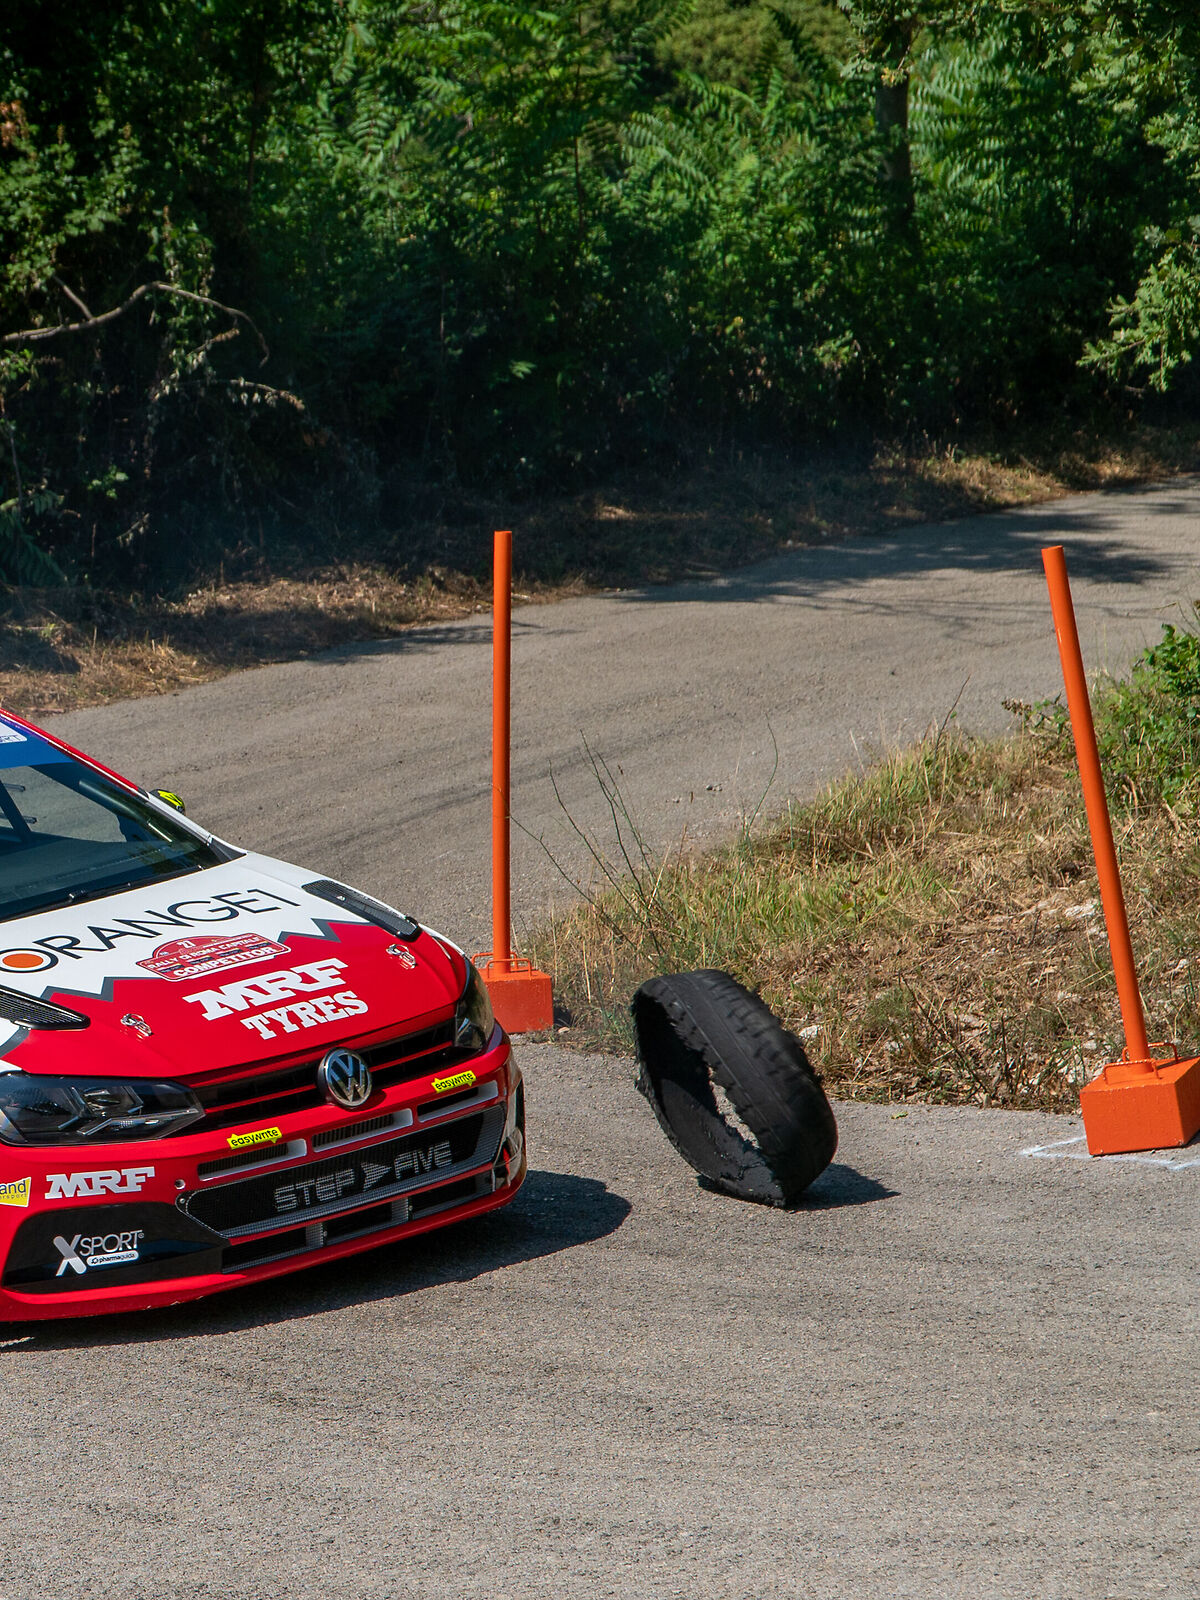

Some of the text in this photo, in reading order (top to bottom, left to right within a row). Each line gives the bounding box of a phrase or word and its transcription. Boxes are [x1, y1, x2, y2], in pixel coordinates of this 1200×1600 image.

[148, 957, 178, 970] RALLY
[173, 946, 277, 977] COMPETITOR
[182, 957, 349, 1021] MRF
[240, 990, 369, 1040] TYRES
[435, 1071, 475, 1091] easywrite
[230, 1128, 279, 1147] easywrite
[45, 1166, 155, 1199] MRF
[274, 1141, 452, 1212] STEP FIVE
